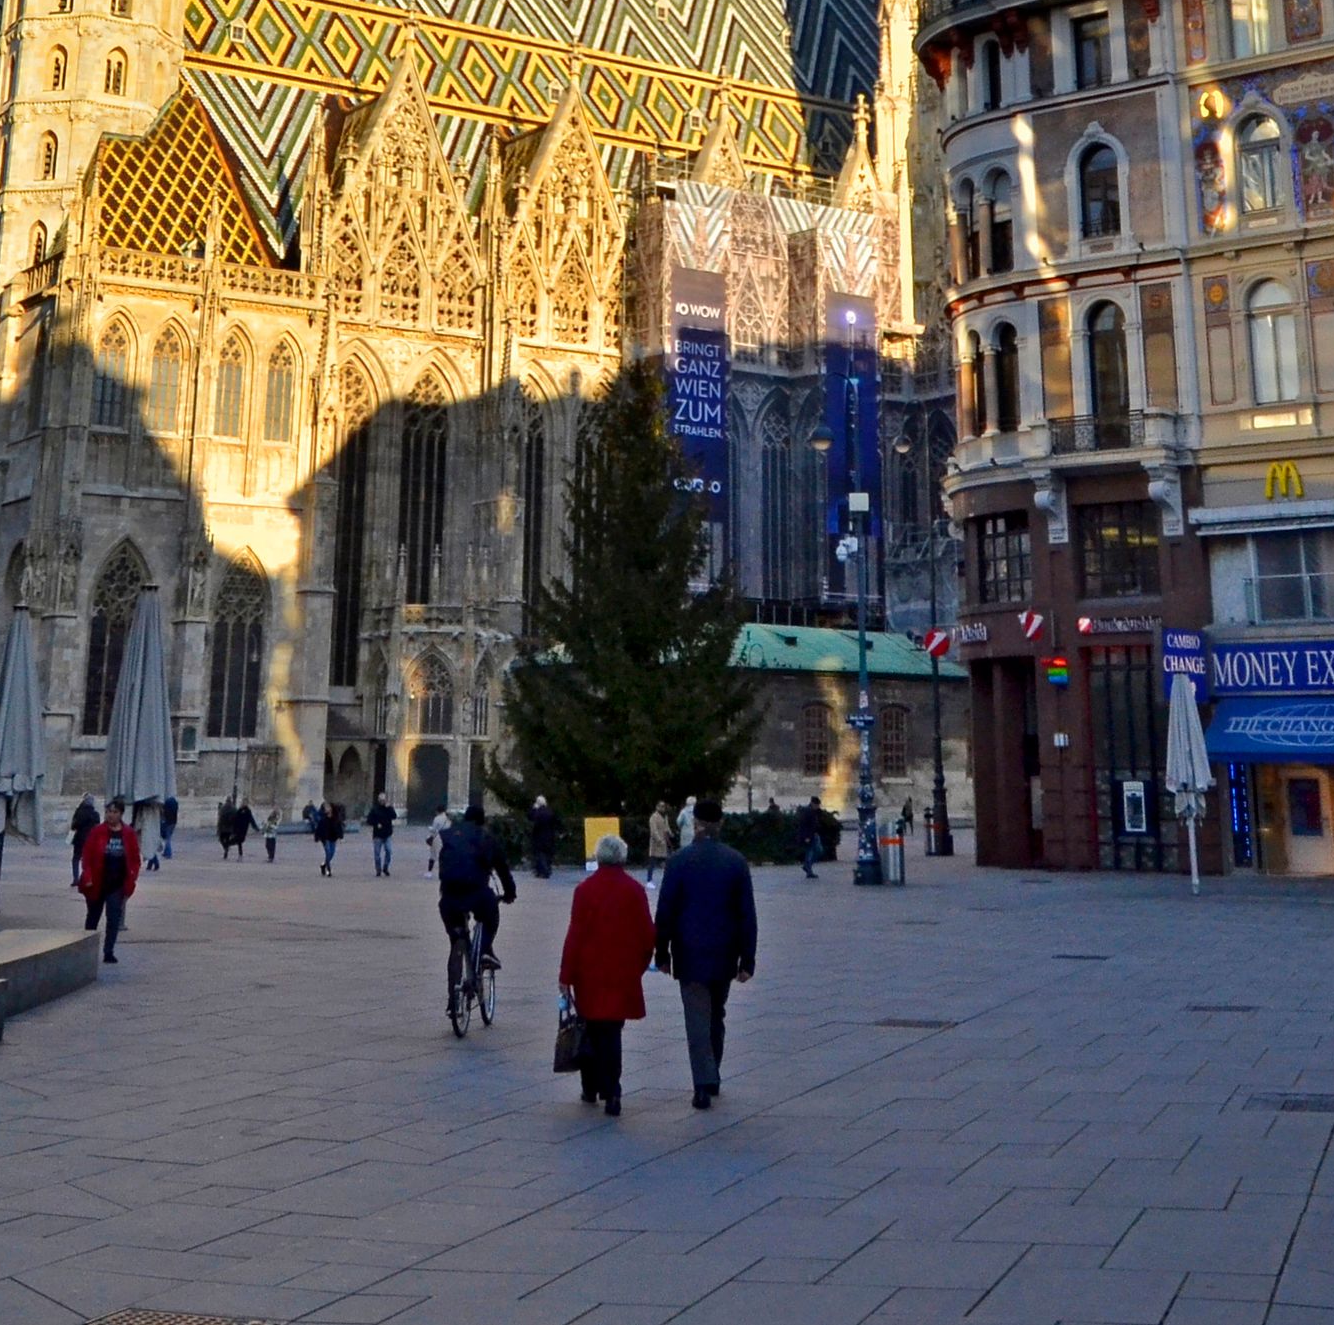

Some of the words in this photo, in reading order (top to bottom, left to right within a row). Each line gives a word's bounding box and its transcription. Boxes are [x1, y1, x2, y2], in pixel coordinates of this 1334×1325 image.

[690, 304, 720, 318] WOW
[675, 339, 720, 358] BRINGT
[675, 357, 720, 378] GANZ
[675, 377, 721, 398] WIEN
[675, 398, 721, 424] ZUM
[1167, 633, 1200, 650] CAMBIO
[1163, 655, 1206, 674] CHANGE
[1212, 650, 1299, 688] MONEY
[1227, 717, 1263, 732] THE
